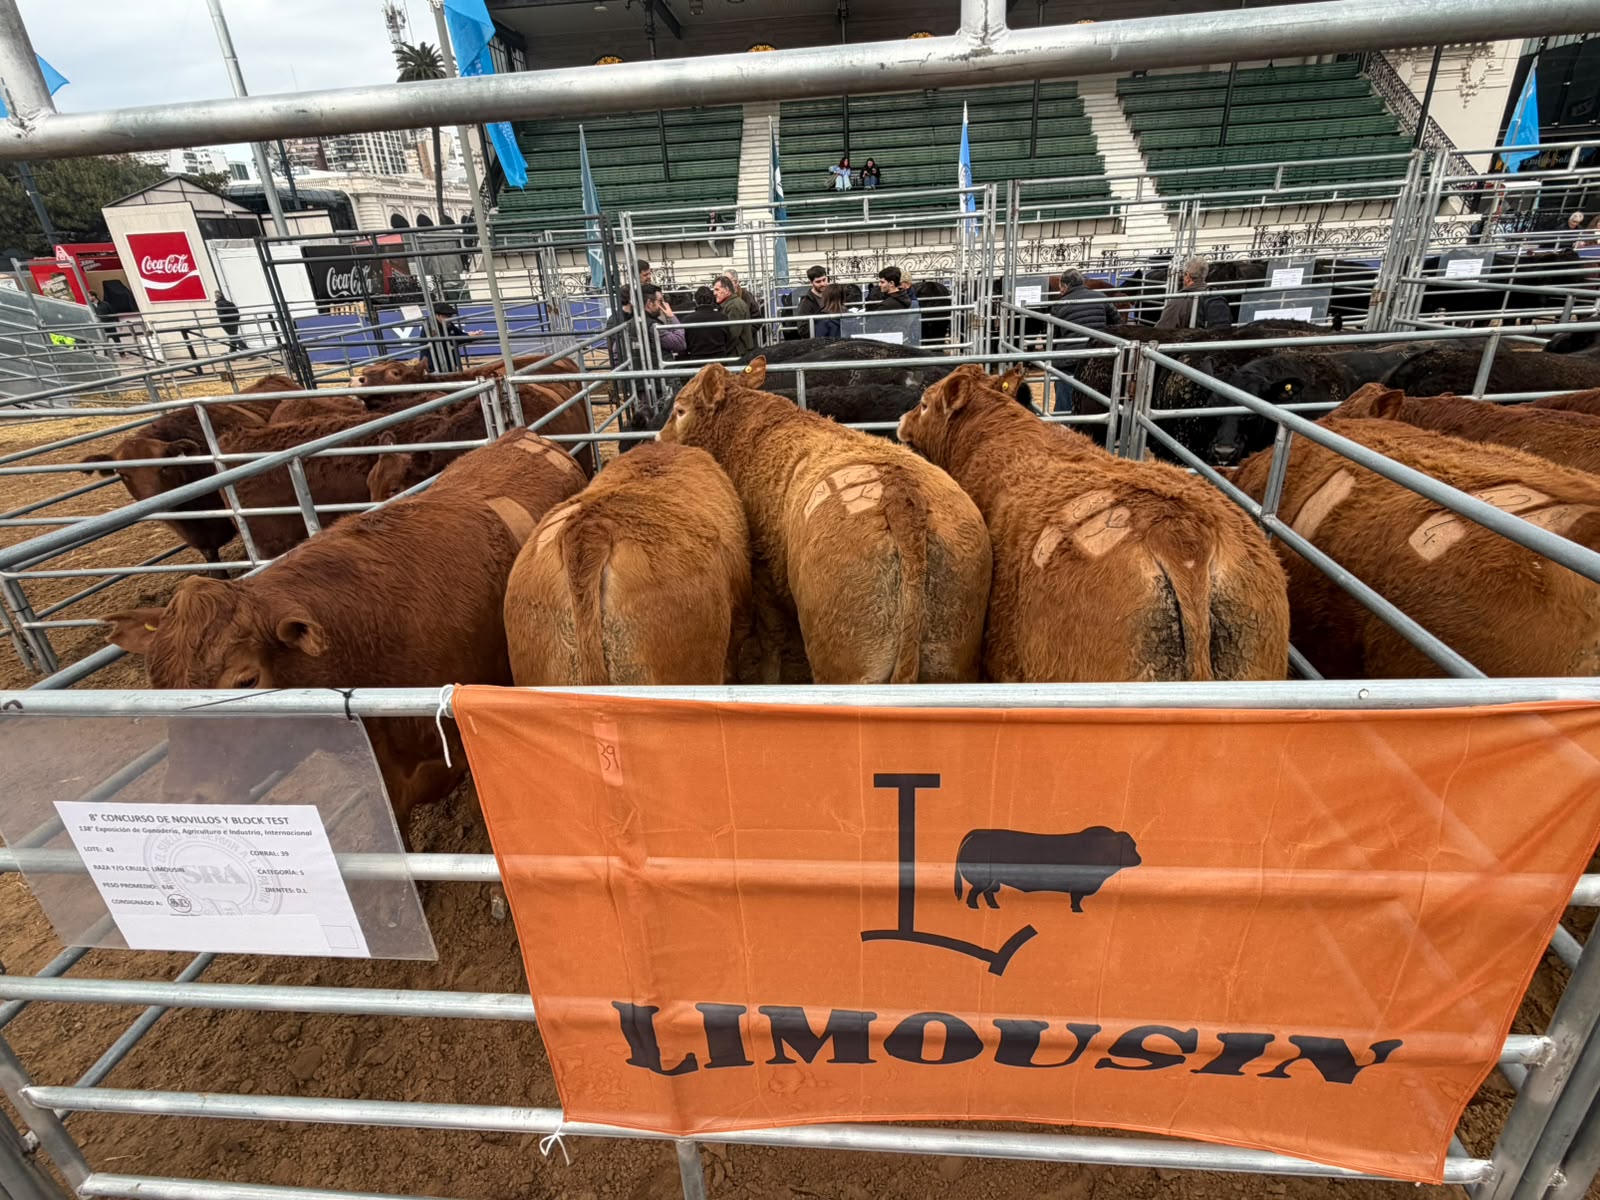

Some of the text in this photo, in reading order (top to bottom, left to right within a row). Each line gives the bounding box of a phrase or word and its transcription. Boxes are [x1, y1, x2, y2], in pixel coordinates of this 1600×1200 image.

[141, 254, 189, 275] Coca-Cola
[596, 741, 619, 771] 39
[101, 814, 154, 823] CONCURSO
[156, 815, 170, 823] DE
[172, 815, 221, 824] NOVILLOS
[222, 816, 229, 824] Y
[231, 817, 265, 825] BLOCK
[265, 817, 289, 825] TEST
[182, 828, 222, 836] Agricultura
[182, 864, 248, 884] SRA
[111, 898, 154, 906] CONSIGNADO
[613, 1001, 1404, 1085] LIMOUSIN
